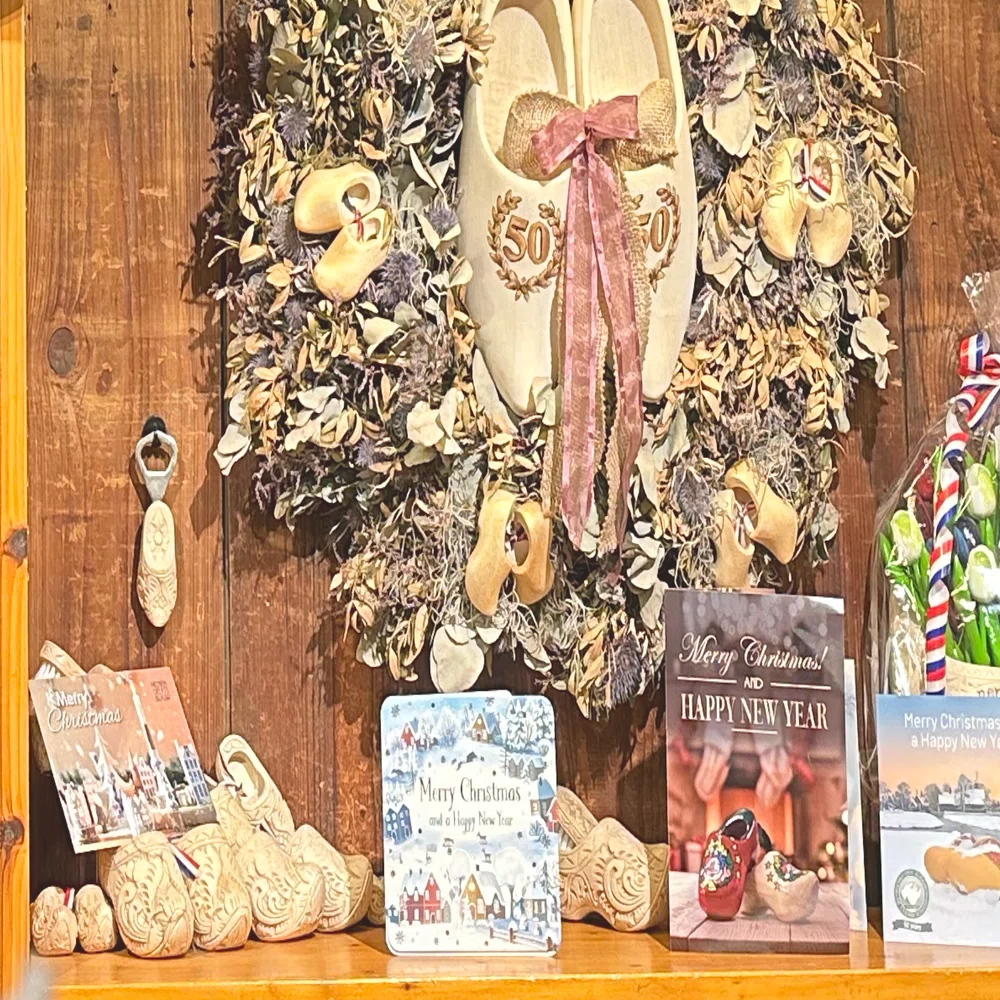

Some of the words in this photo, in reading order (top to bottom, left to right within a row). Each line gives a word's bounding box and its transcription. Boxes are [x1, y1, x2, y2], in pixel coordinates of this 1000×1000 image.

[502, 214, 550, 264] 50
[679, 632, 735, 676] Merry
[740, 636, 828, 670] Christmas!
[744, 676, 764, 689] AND
[55, 685, 91, 711] Merry
[48, 707, 123, 732] Christmas
[681, 693, 736, 723] HAPPY
[740, 697, 779, 726] NEW
[783, 701, 828, 730] YEAR
[904, 713, 938, 732] Merry
[940, 713, 1000, 730] Christmas
[911, 735, 919, 748] a
[921, 733, 958, 752] Happy
[960, 734, 987, 749] New
[419, 777, 455, 811] Merry
[460, 777, 520, 802] Christmas
[429, 813, 442, 826] and
[445, 817, 450, 826] a
[453, 810, 475, 834] Happy
[478, 810, 495, 826] New
[497, 810, 513, 826] Year
